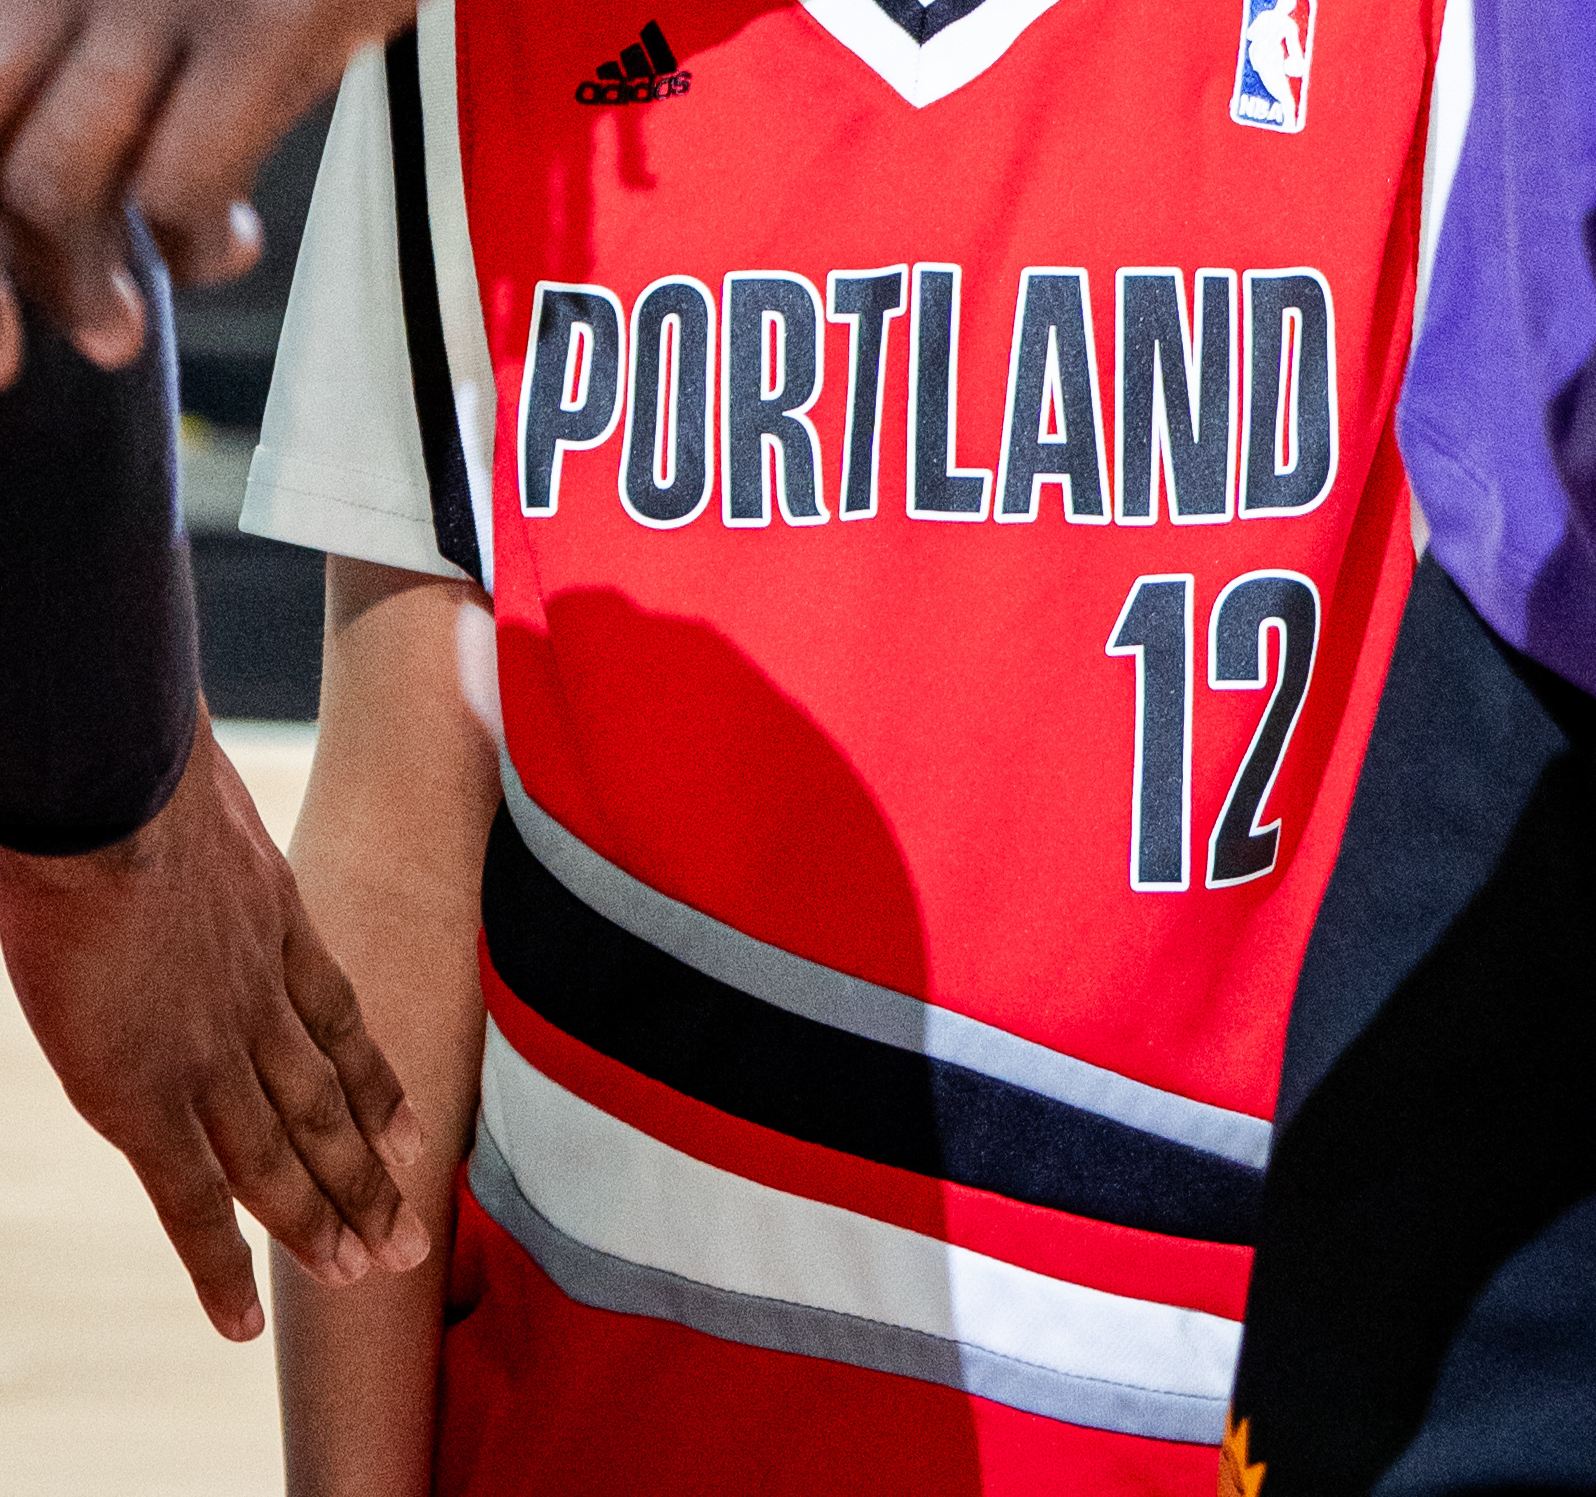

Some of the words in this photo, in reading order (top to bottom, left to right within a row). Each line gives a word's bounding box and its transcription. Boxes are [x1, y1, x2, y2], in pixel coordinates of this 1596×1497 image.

[574, 69, 692, 106] adidas
[1237, 93, 1285, 125] NBA
[517, 261, 1341, 530] PORTLAND
[1103, 566, 1323, 894] 12
